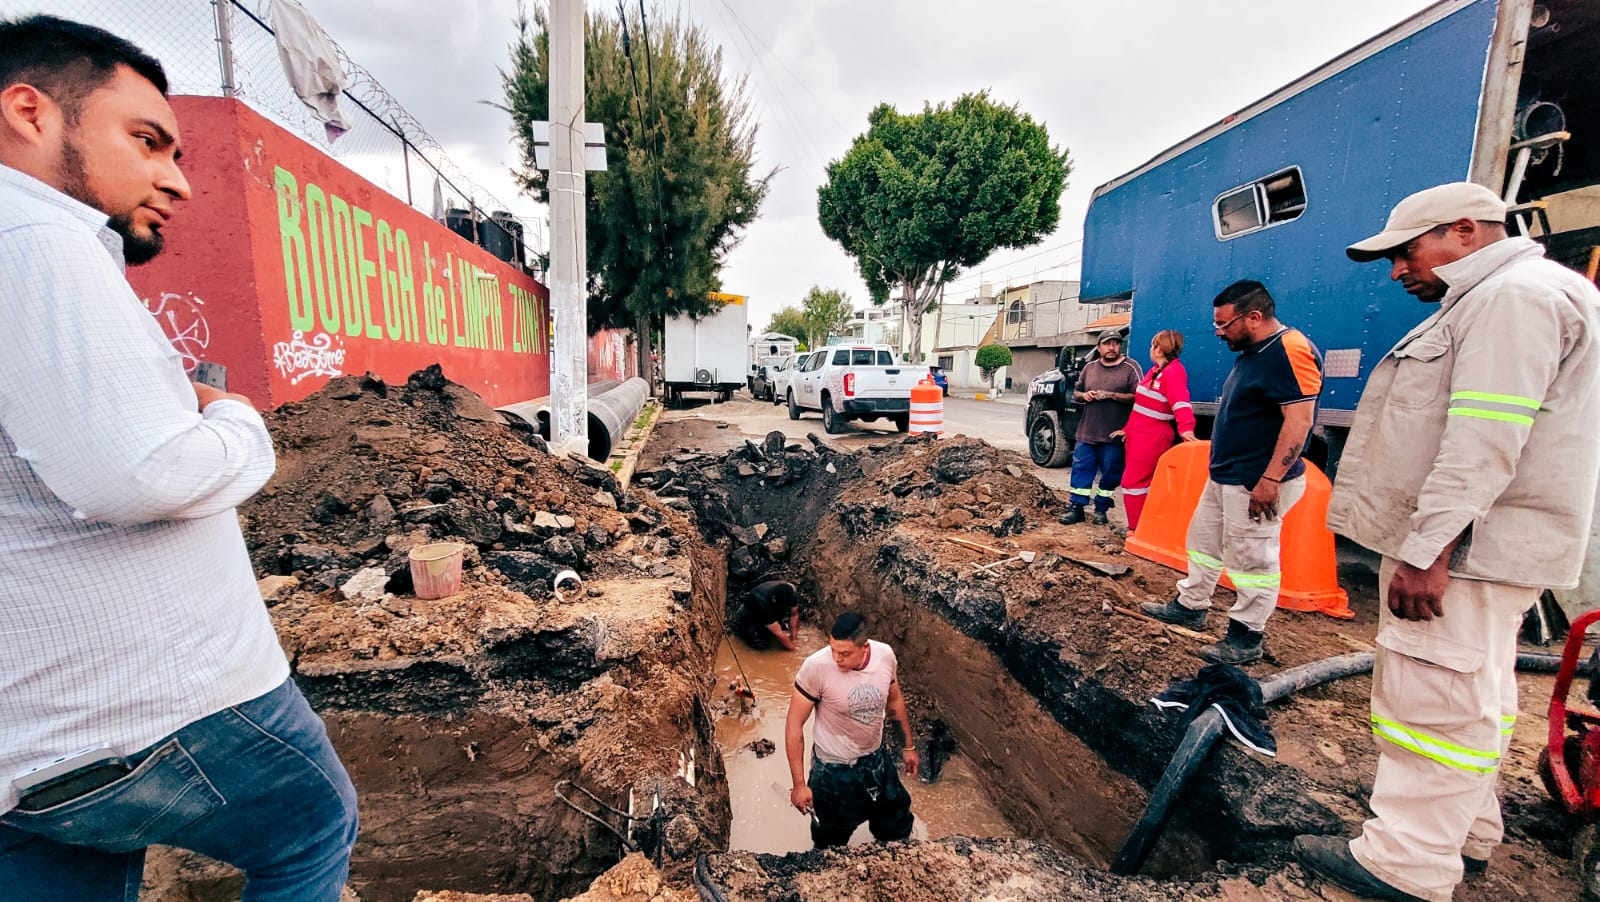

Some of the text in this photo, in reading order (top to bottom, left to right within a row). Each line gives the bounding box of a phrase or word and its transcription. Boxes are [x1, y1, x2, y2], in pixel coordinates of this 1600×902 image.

[274, 165, 420, 343] BODEGA
[423, 240, 448, 346] de
[446, 251, 505, 351] LIMPIA
[508, 282, 541, 355] ZONA
